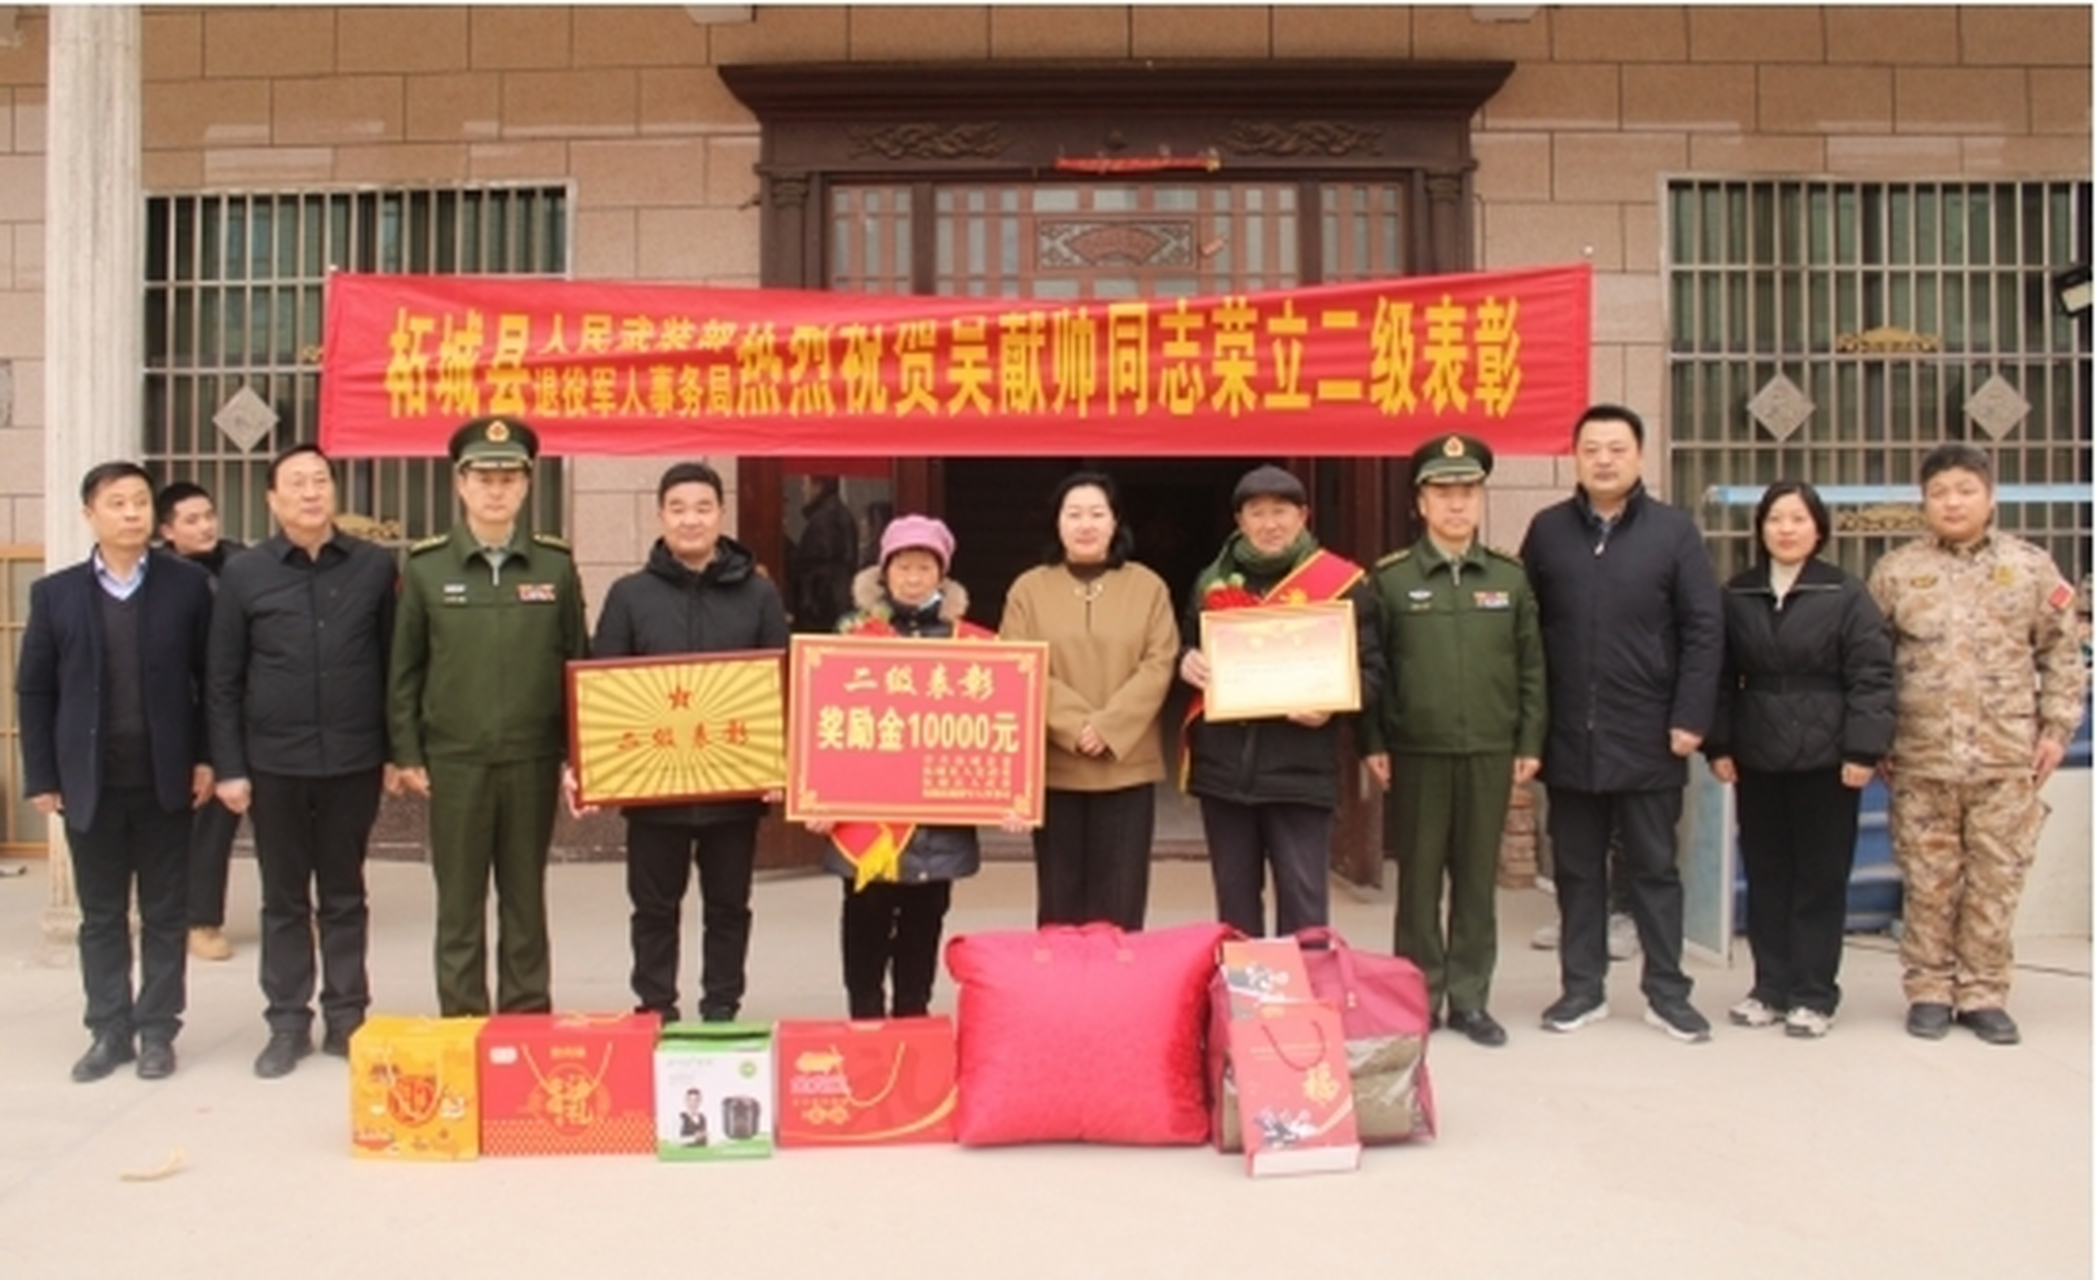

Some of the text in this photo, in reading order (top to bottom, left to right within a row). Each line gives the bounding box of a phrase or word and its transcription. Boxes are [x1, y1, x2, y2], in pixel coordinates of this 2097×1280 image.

[384, 307, 530, 419] 柘城县
[534, 364, 735, 419] 退役军人事务局
[843, 661, 994, 700] 二级表彰
[817, 705, 1020, 754] 奖励金10000元
